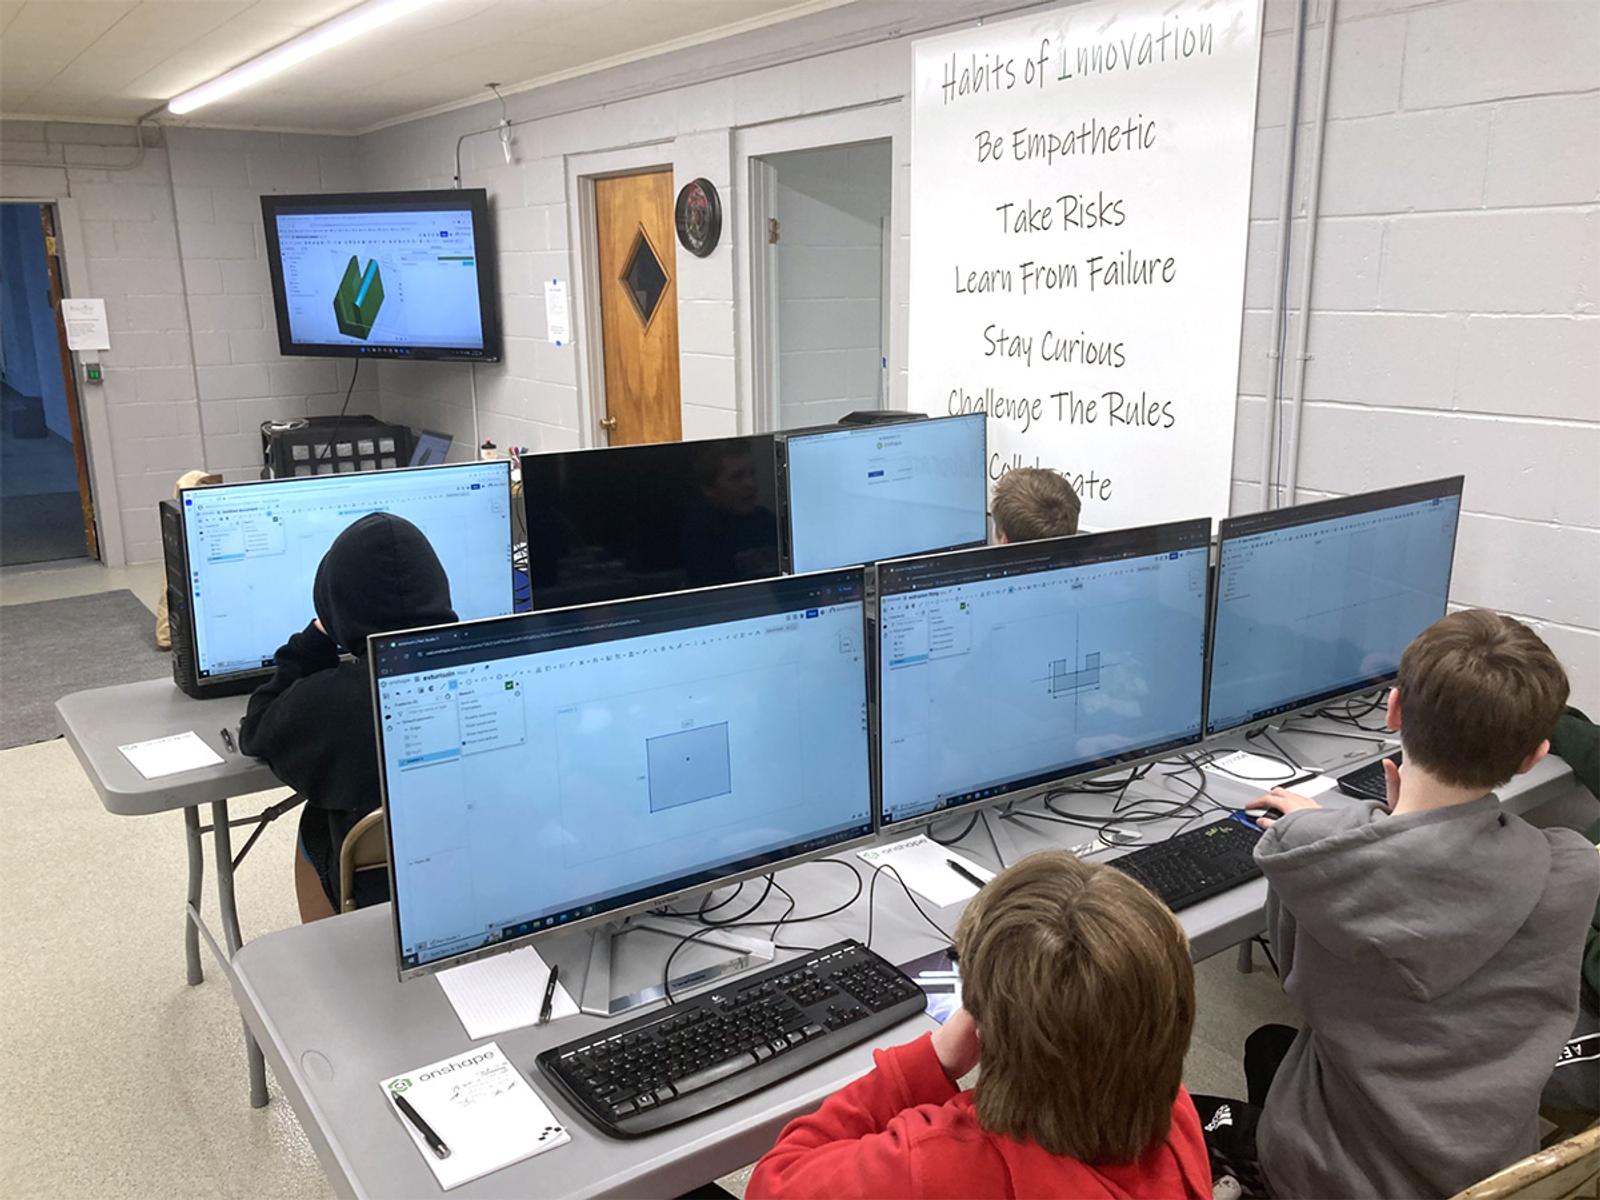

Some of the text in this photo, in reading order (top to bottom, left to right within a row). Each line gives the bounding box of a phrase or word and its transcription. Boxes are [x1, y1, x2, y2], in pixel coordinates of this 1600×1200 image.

[942, 15, 1213, 104] Habits of Innovation
[975, 114, 1157, 165] Be Empathetic
[996, 191, 1126, 234] Take Risks
[955, 249, 1176, 295] Learn From Failure
[984, 324, 1126, 368] Stay Curious
[948, 387, 1176, 433] Challenge The Rules
[989, 453, 1112, 501] Collate
[418, 1050, 495, 1082] onshape
[1558, 1043, 1582, 1060] AE
